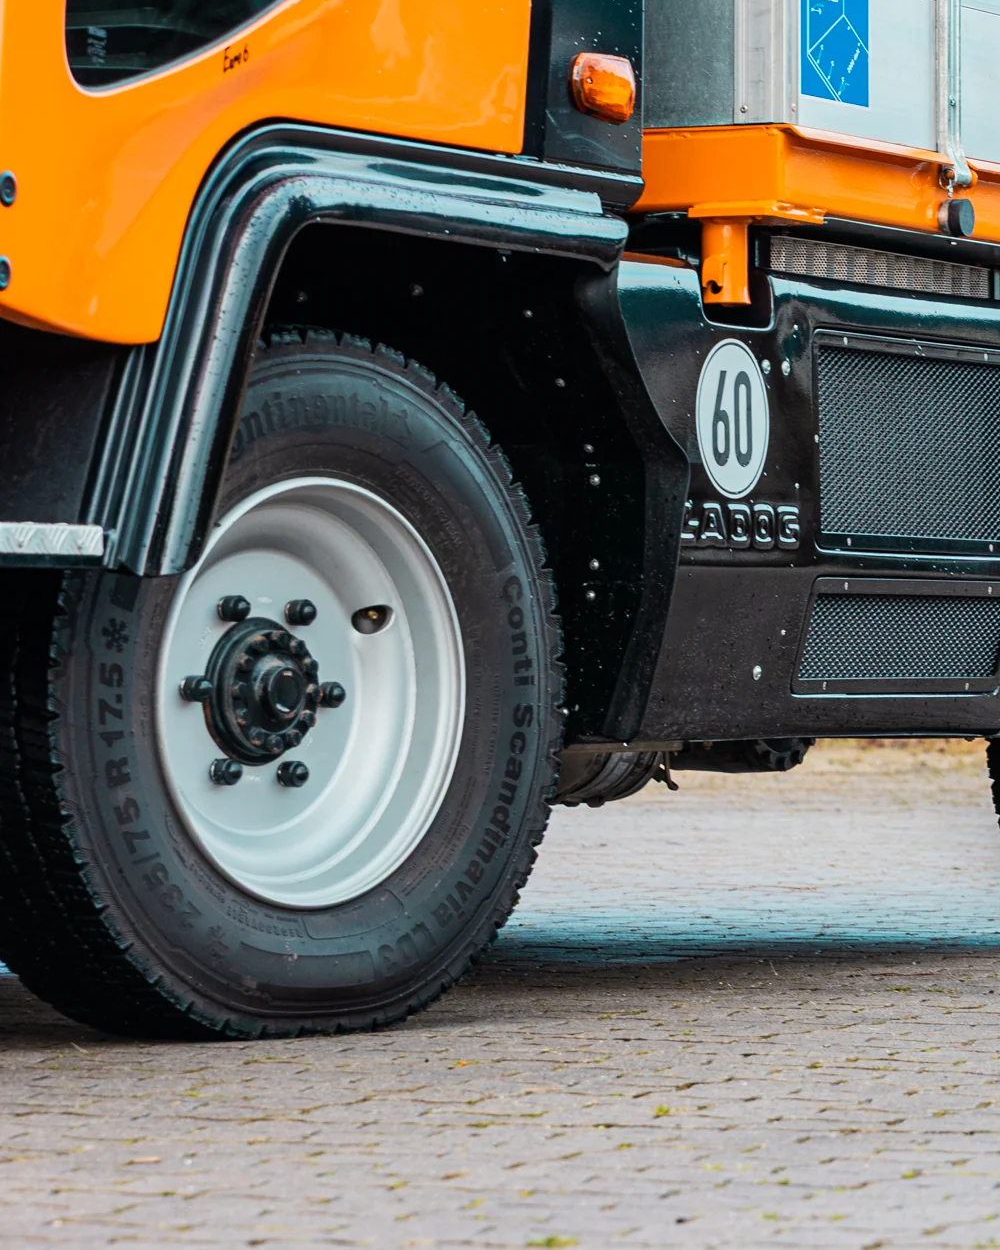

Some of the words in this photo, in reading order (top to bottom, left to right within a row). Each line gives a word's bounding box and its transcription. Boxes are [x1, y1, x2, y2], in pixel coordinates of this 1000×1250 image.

[224, 391, 390, 461] ontinental
[712, 369, 753, 468] 60
[681, 501, 799, 549] LADOG
[502, 575, 535, 686] Conti
[98, 662, 125, 748] 17.5
[105, 756, 132, 790] R
[430, 702, 534, 930] Scandinavia
[112, 796, 199, 931] 235/75
[377, 920, 438, 977] LD3
